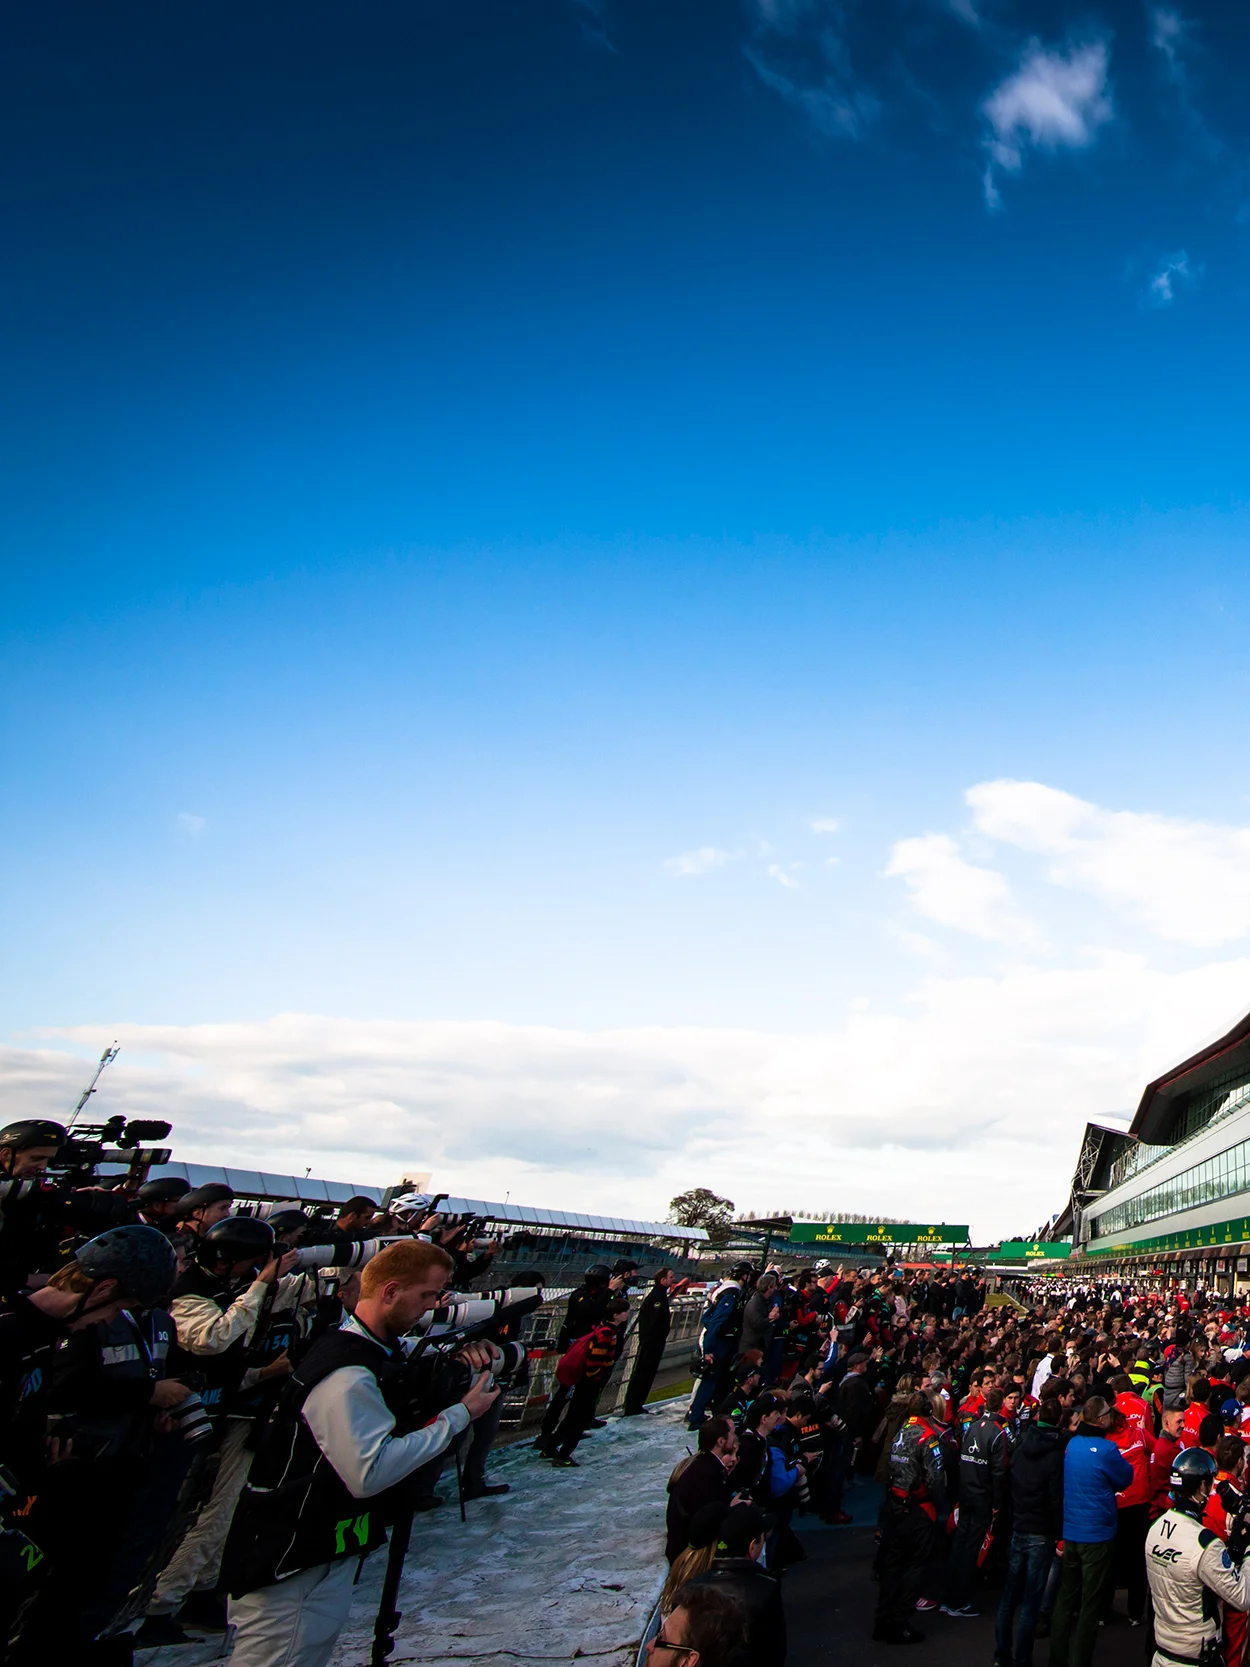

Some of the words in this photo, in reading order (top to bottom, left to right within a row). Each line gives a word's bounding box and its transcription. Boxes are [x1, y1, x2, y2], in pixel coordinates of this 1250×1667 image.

[815, 1233, 842, 1242] ROLEX
[866, 1234, 893, 1242] ROLEX
[800, 1423, 820, 1435] TRACK
[334, 1511, 370, 1554] TV
[1160, 1518, 1177, 1540] TV
[1152, 1544, 1182, 1564] WEC
